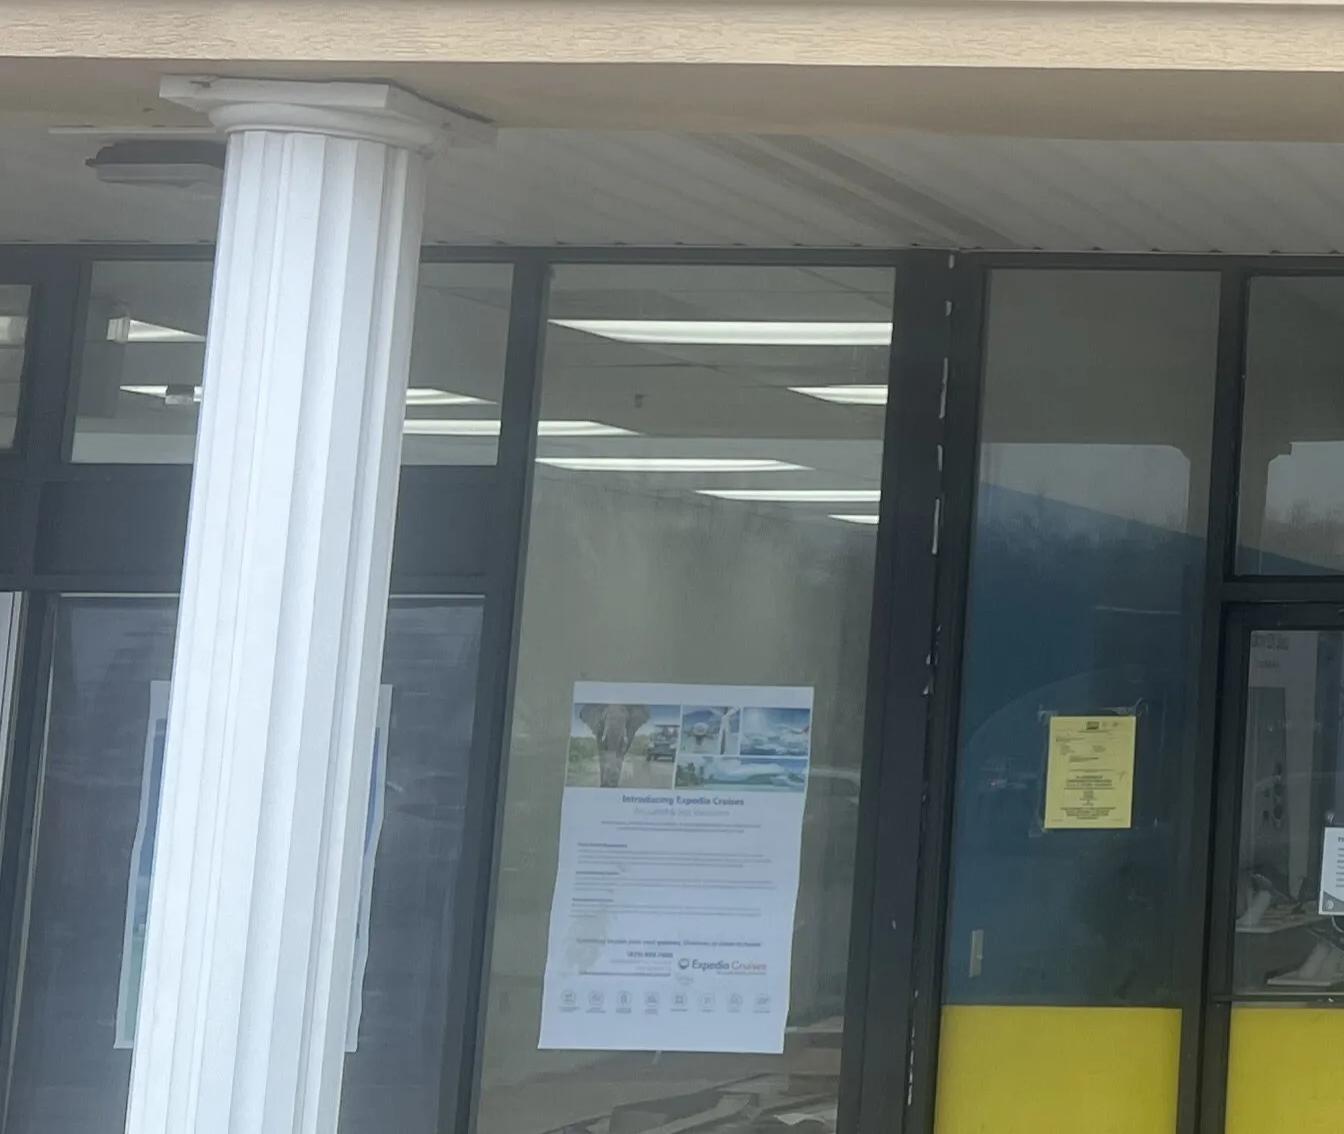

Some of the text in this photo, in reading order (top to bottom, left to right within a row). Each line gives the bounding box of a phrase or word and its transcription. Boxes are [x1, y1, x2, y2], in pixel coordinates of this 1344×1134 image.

[622, 794, 745, 806] Introducing Expedia Cruises
[691, 958, 730, 972] Expedia
